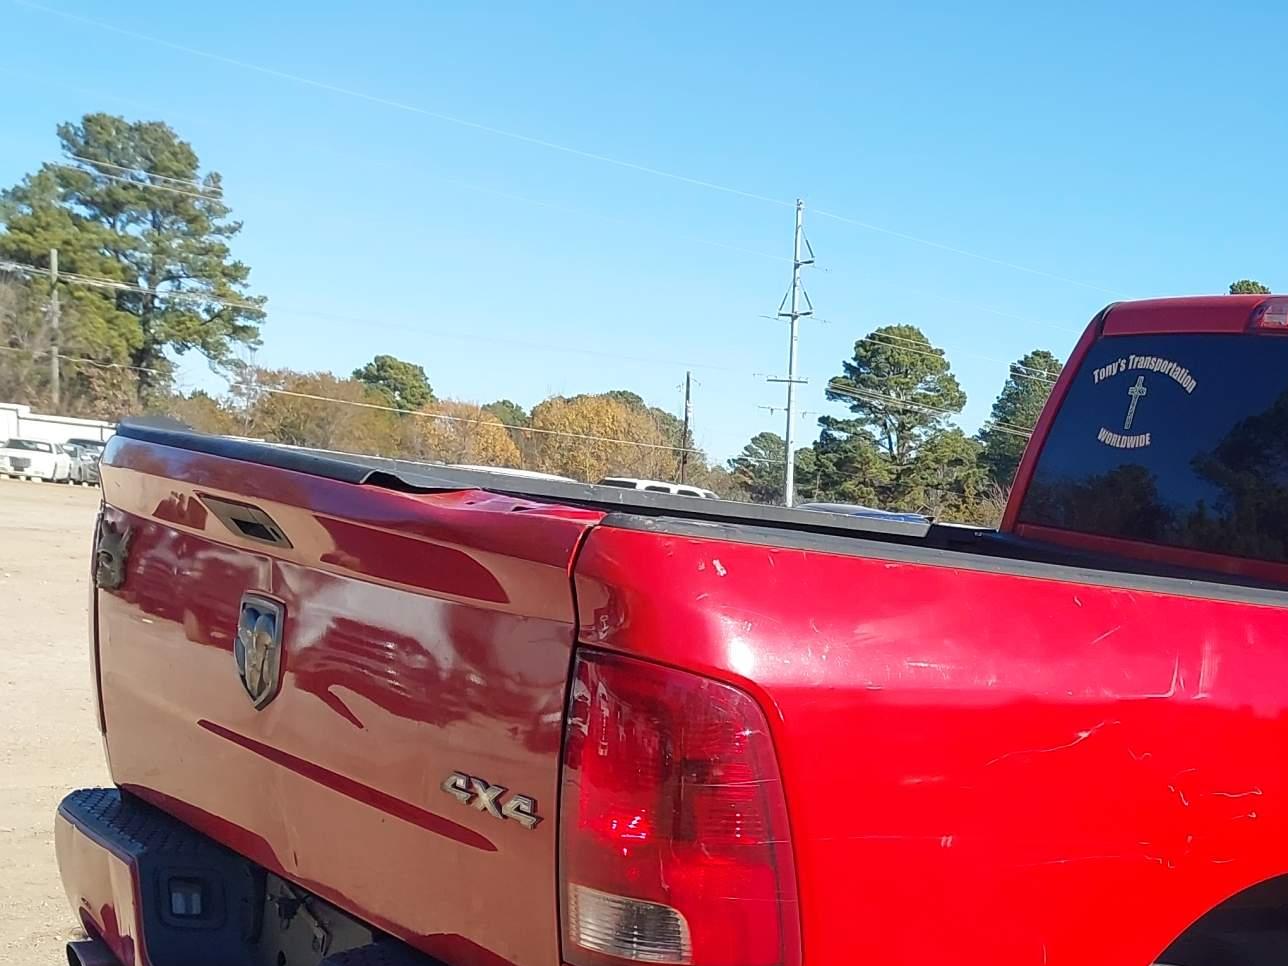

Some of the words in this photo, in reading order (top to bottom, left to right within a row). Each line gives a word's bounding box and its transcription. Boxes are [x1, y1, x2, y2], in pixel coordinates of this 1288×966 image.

[1093, 358, 1127, 384] Tony's
[1128, 355, 1197, 393] Transportation
[1098, 427, 1151, 448] WORLDWIDE
